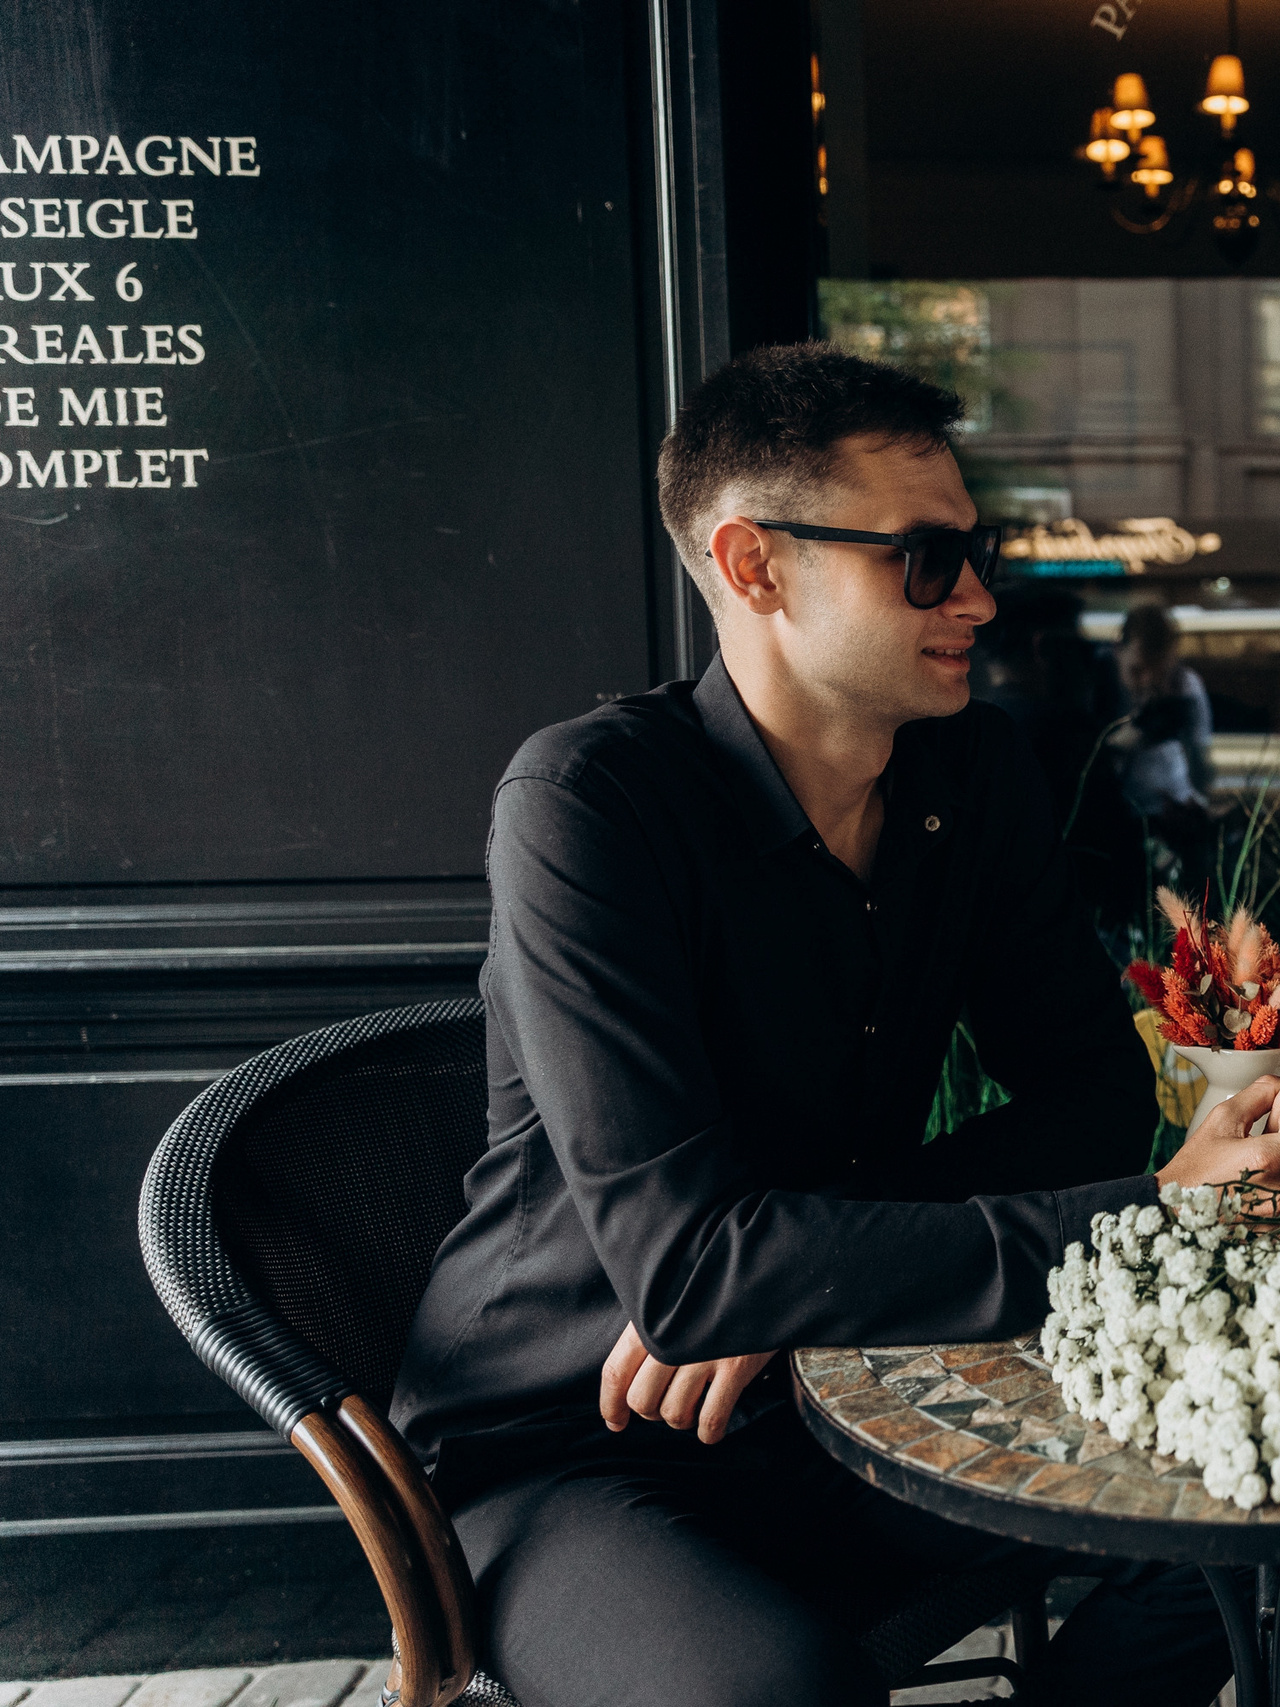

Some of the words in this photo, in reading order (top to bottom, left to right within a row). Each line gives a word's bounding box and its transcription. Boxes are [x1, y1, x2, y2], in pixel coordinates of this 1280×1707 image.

[0, 197, 199, 240] SEIGLE
[0, 262, 96, 302] UX
[116, 262, 144, 303] 6
[59, 387, 168, 428] MIE
